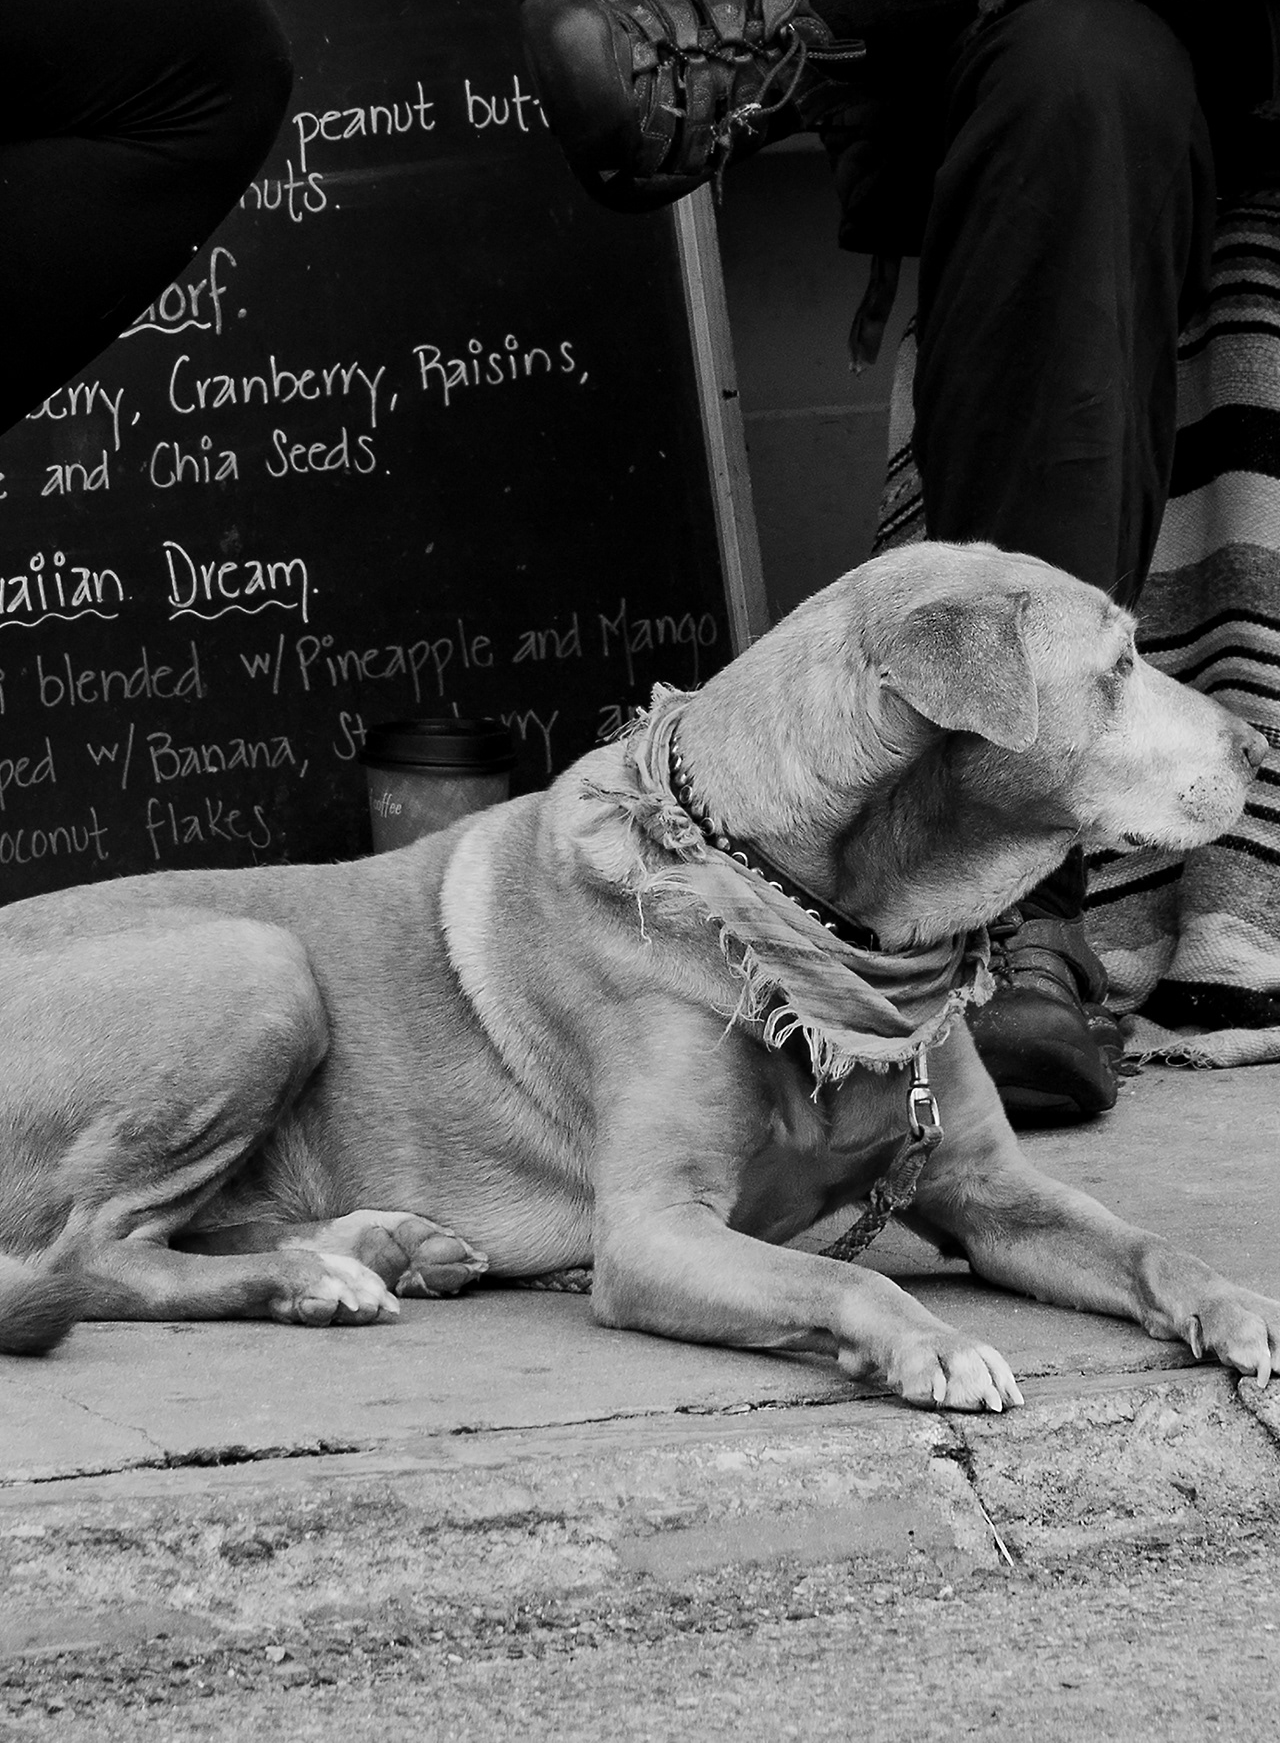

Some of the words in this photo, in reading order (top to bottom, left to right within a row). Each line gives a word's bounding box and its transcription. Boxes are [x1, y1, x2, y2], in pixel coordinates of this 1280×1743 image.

[292, 81, 436, 172] peanut
[170, 354, 399, 428] Cranberry,
[413, 334, 589, 407] Raisins,
[41, 449, 110, 496] and
[150, 435, 238, 487] Chia
[266, 428, 391, 477] Seeds.
[163, 541, 318, 622] Dream.
[38, 641, 205, 706] blended
[513, 615, 581, 664] and
[599, 599, 718, 682] Mango
